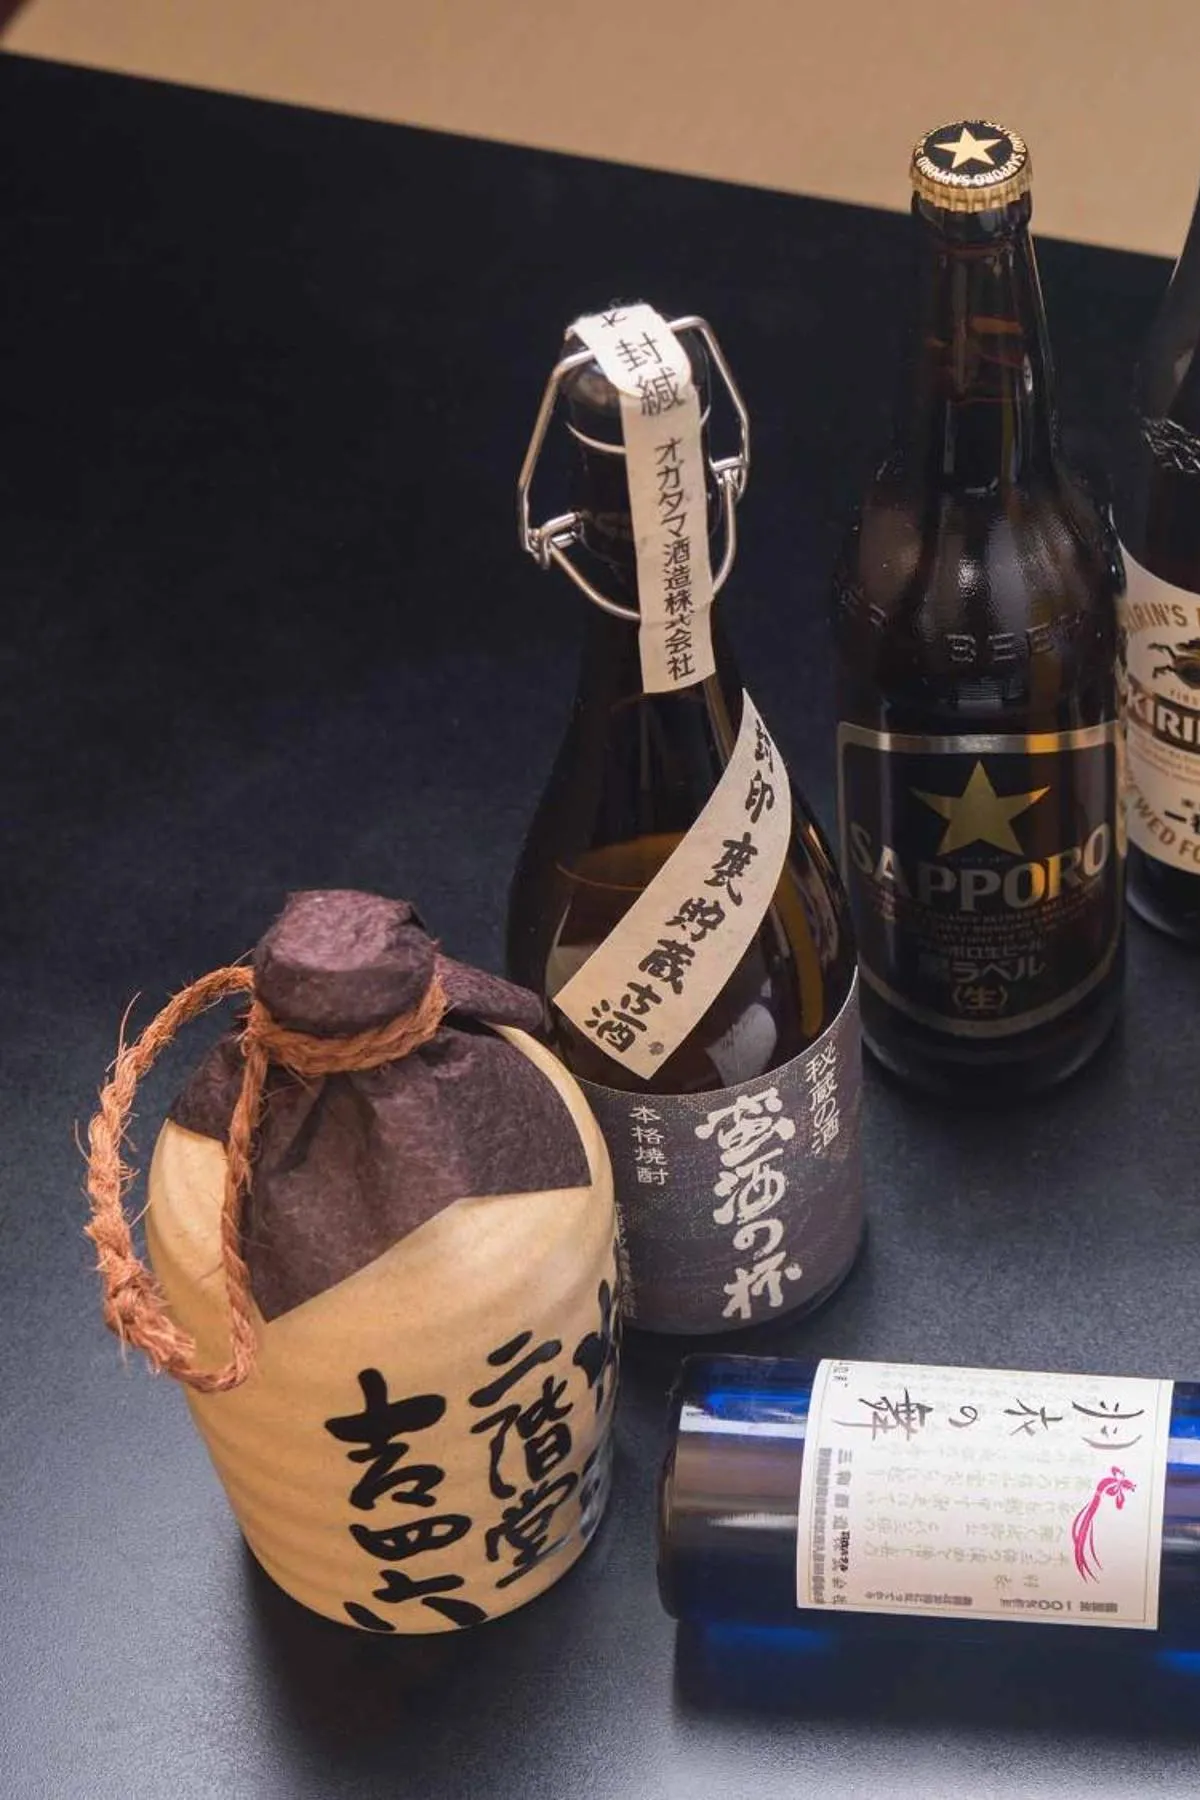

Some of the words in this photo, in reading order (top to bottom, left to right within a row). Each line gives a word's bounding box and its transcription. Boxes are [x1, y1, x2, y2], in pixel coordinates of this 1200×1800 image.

[654, 436, 697, 682] オガタマ酒造株式会社
[850, 821, 1110, 913] SAPPORO
[628, 1105, 670, 1187] 本格焼酎
[323, 1367, 490, 1632] 吉四六
[467, 1329, 580, 1590] 二階堂
